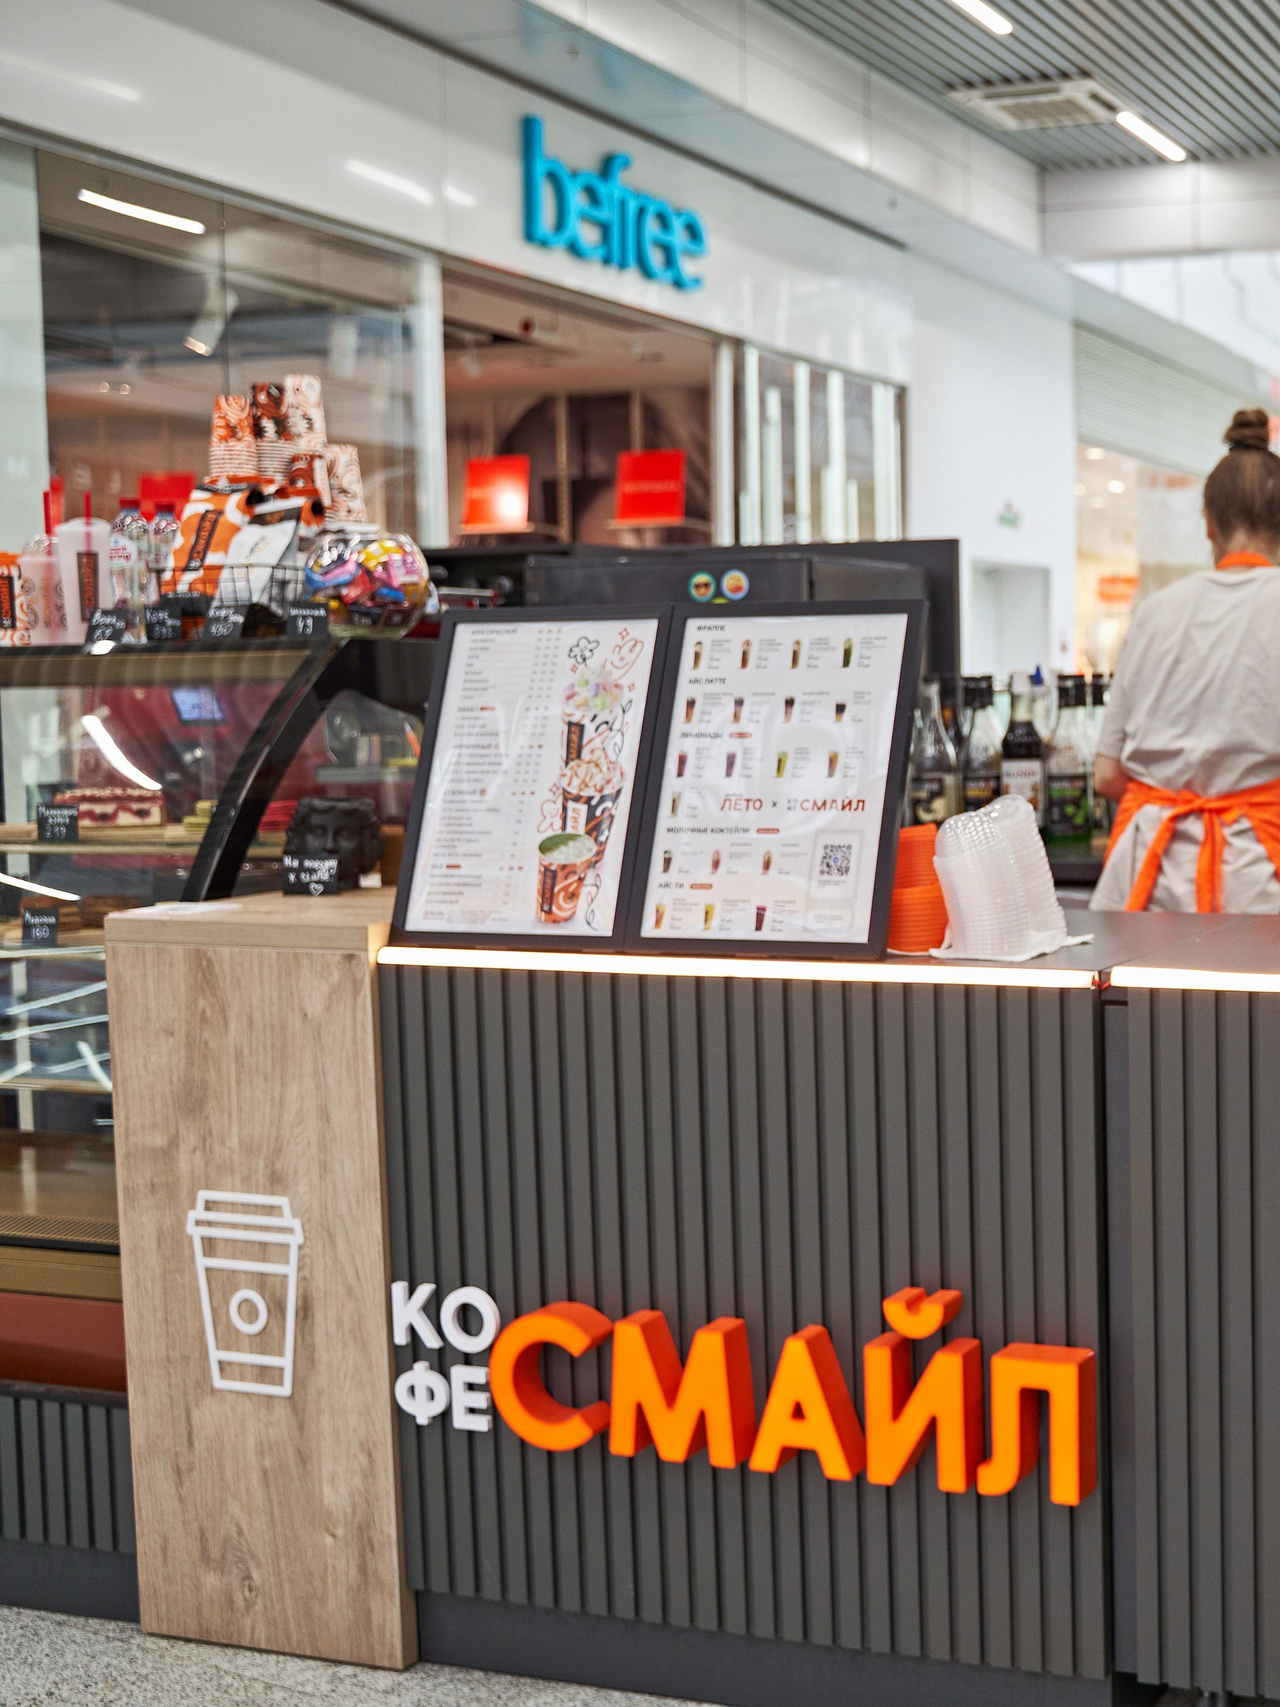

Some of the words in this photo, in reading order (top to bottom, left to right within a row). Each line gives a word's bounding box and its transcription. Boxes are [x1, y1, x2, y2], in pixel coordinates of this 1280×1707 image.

[523, 115, 707, 290] befree
[720, 798, 763, 811] ЛЕТО
[800, 796, 866, 812] СМАЙЛ
[391, 1280, 500, 1355] КО
[489, 1287, 1097, 1507] СМАЙЛ
[395, 1360, 493, 1432] ФЕ
